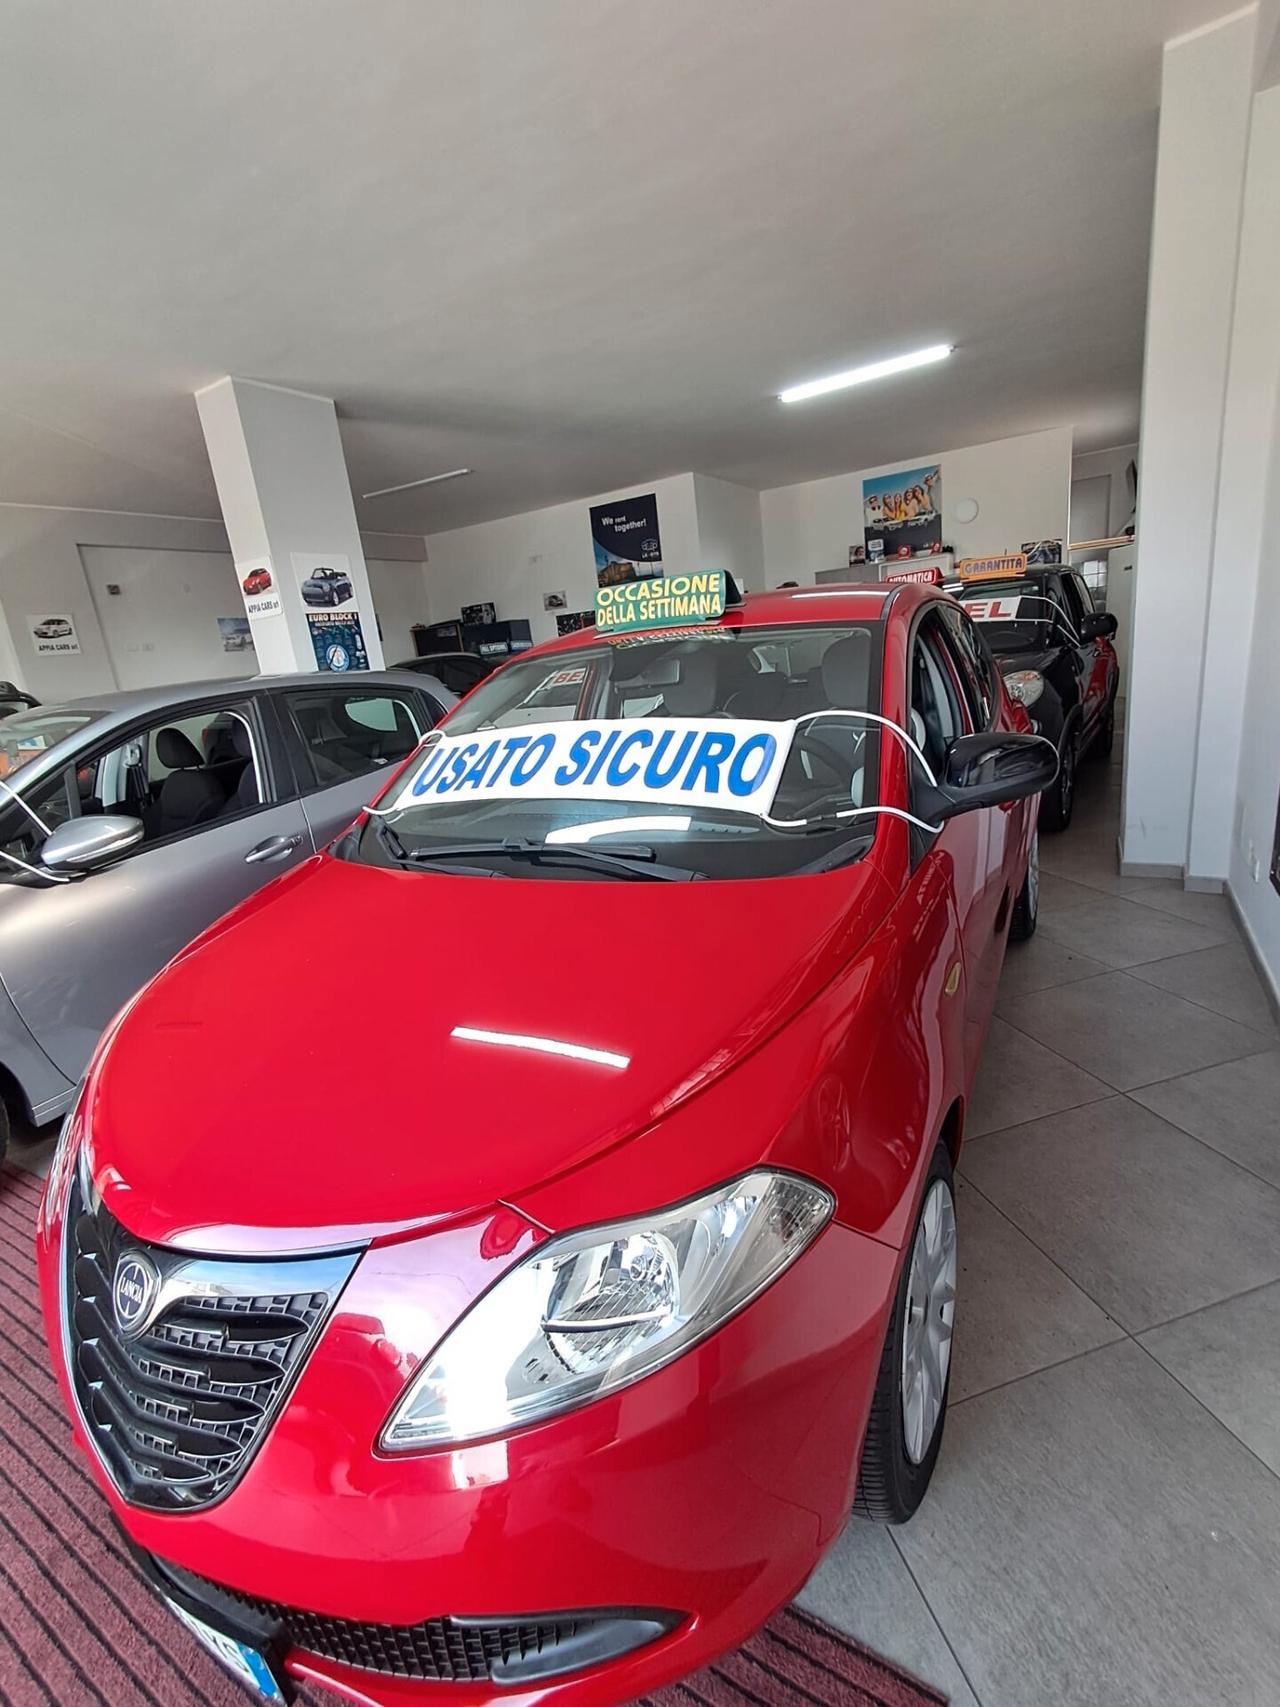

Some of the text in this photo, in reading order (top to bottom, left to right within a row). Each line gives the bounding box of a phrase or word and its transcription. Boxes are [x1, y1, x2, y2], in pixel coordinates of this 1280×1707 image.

[601, 517, 614, 526] We
[614, 518, 647, 533] together!
[964, 557, 1022, 575] GARANTITA
[596, 573, 720, 606] OCCASIONE
[309, 614, 328, 622] EURO
[330, 613, 352, 621] BLOCK
[597, 594, 721, 627] DELLA SETTIMANA
[553, 671, 583, 684] BE
[412, 729, 777, 797] USATO SICURO
[120, 1276, 143, 1304] LANCIA
